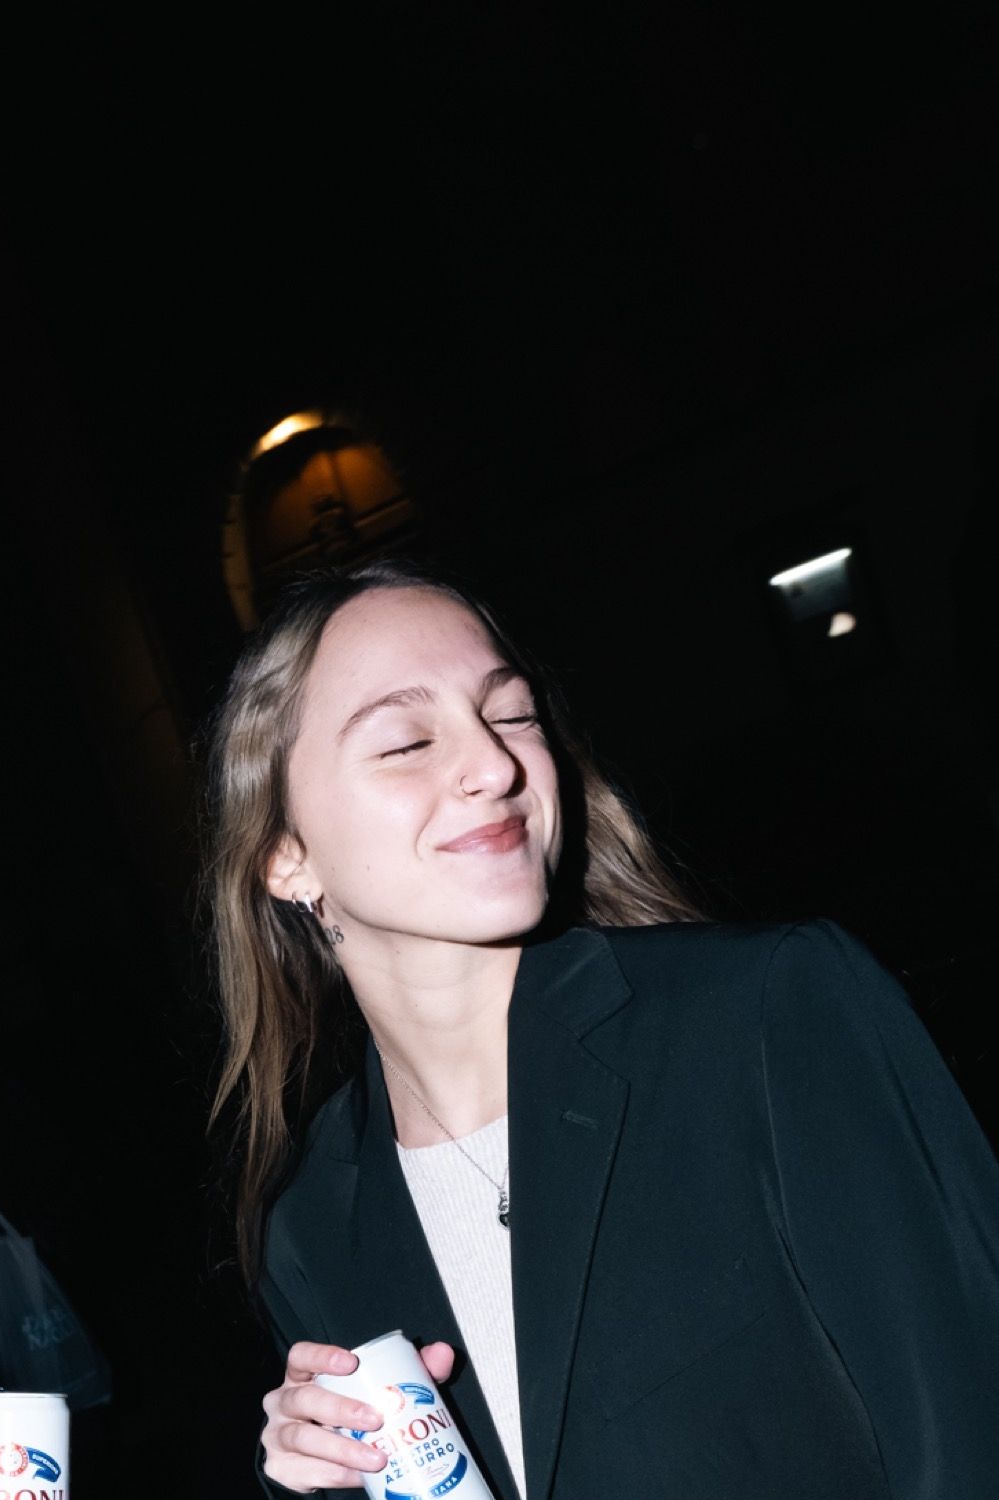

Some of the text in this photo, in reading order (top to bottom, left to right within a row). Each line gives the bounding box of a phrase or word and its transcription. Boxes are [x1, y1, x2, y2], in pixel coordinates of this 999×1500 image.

[371, 1408, 451, 1456] ERONI
[389, 1438, 440, 1468] NTRO
[385, 1442, 455, 1485] AZURRO
